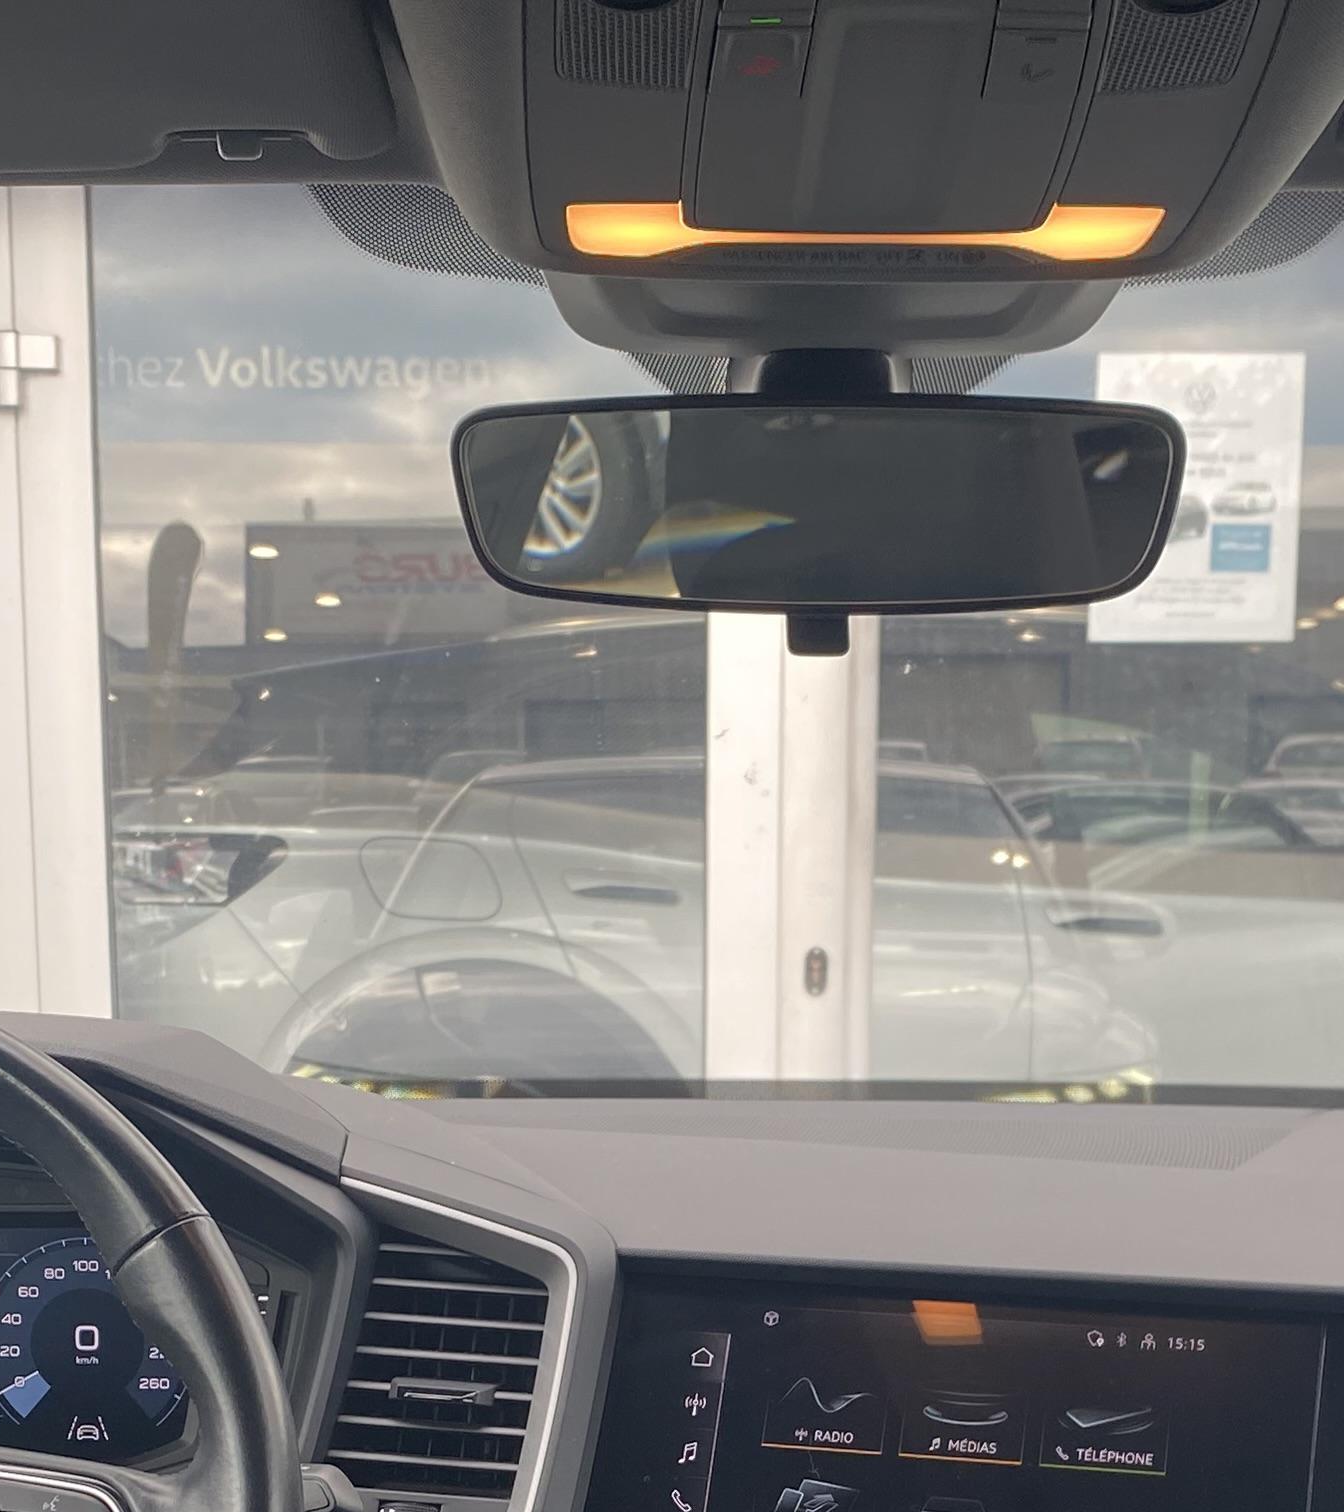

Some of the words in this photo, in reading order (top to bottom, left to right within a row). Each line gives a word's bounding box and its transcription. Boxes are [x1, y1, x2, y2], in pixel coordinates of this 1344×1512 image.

[98, 345, 187, 389] hez
[196, 345, 491, 399] Volkswagen
[73, 1260, 99, 1272] 100
[44, 1268, 65, 1280] 80
[18, 1286, 39, 1298] 60
[1, 1314, 22, 1325] 40
[75, 1325, 99, 1351] 0
[1167, 1336, 1206, 1352] 15:15
[0, 1346, 20, 1357] 20
[76, 1356, 99, 1366] km/h
[139, 1378, 170, 1390] 260
[814, 1429, 854, 1444] RADIO
[947, 1437, 997, 1455] MÉDIAS
[1076, 1446, 1154, 1466] TÉLÉPHONE
